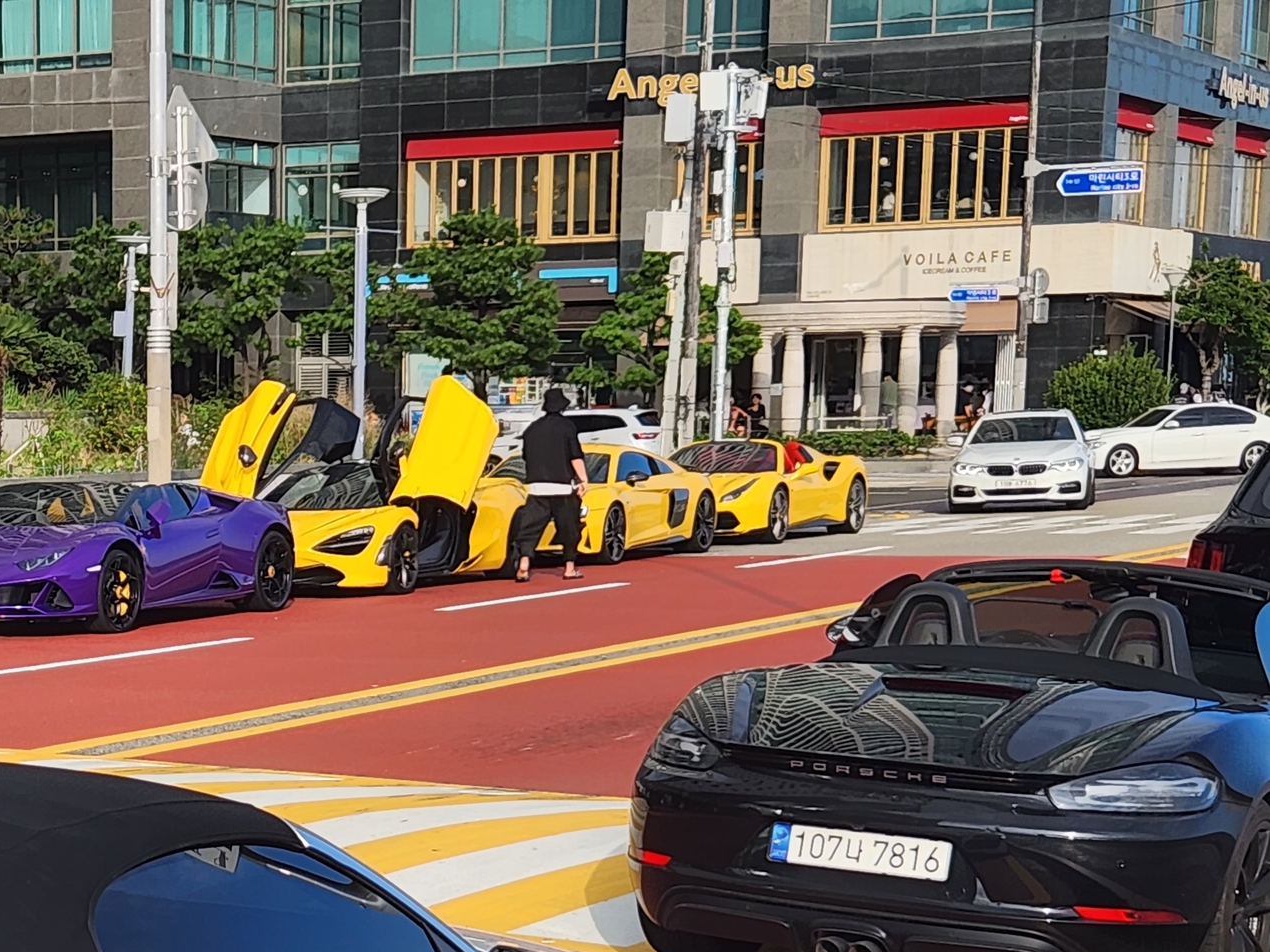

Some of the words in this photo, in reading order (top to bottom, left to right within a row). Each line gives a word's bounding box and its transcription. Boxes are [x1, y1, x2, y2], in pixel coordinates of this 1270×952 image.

[903, 252, 957, 266] VOILA
[964, 250, 1012, 263] CAFE
[790, 760, 947, 784] PORSCHE
[795, 831, 863, 864] 107나
[873, 840, 940, 873] 7816
